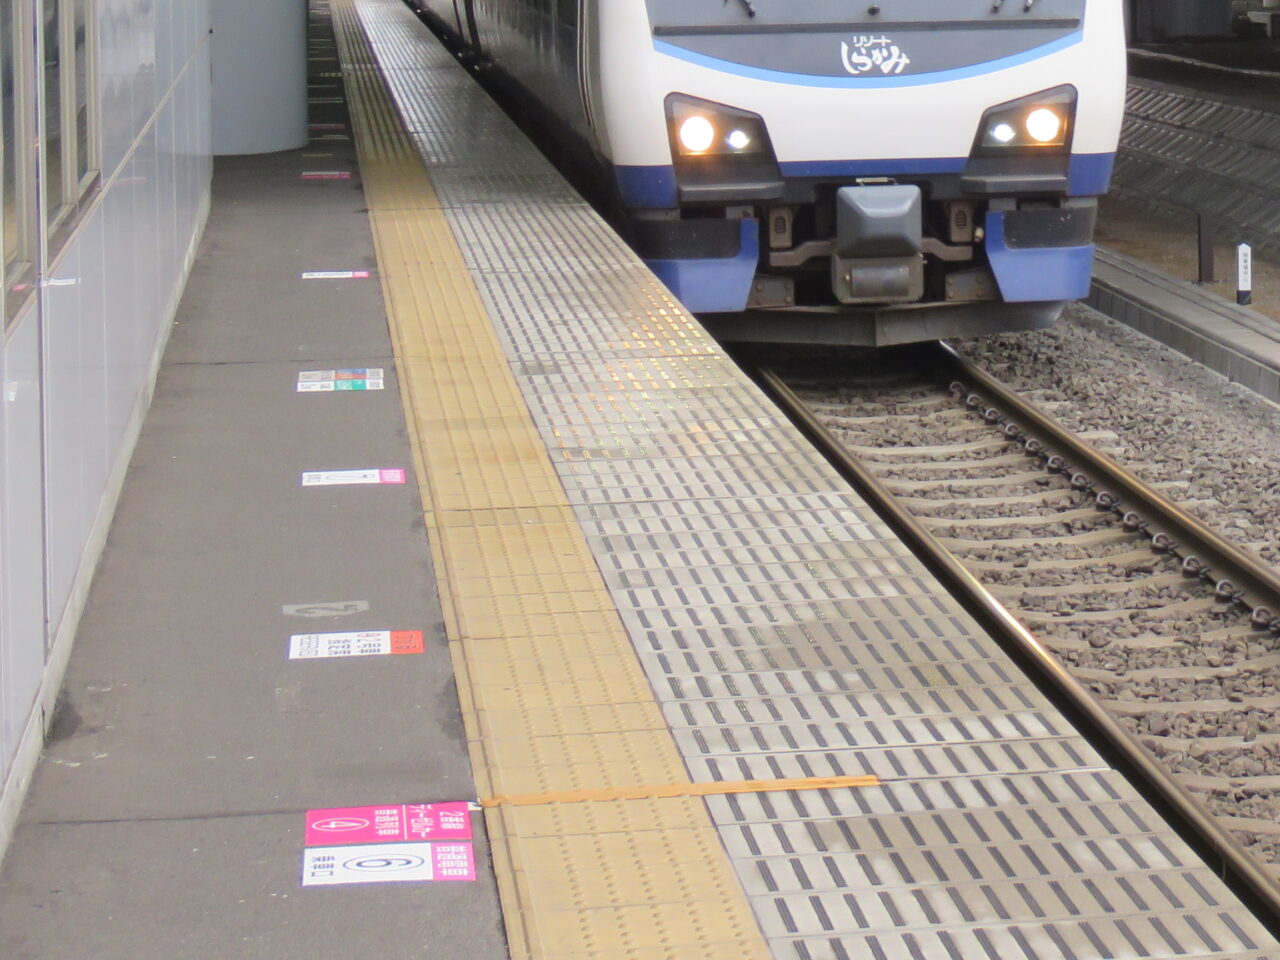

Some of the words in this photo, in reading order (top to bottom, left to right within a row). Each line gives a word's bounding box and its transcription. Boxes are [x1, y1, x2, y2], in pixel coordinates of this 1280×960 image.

[841, 41, 911, 74] しらかみ
[374, 809, 400, 836] 普通列車
[409, 804, 435, 838] ディーゼルカー
[439, 811, 465, 830] 2番線
[311, 855, 336, 878] 乗車口
[436, 846, 469, 877] 普通電車
